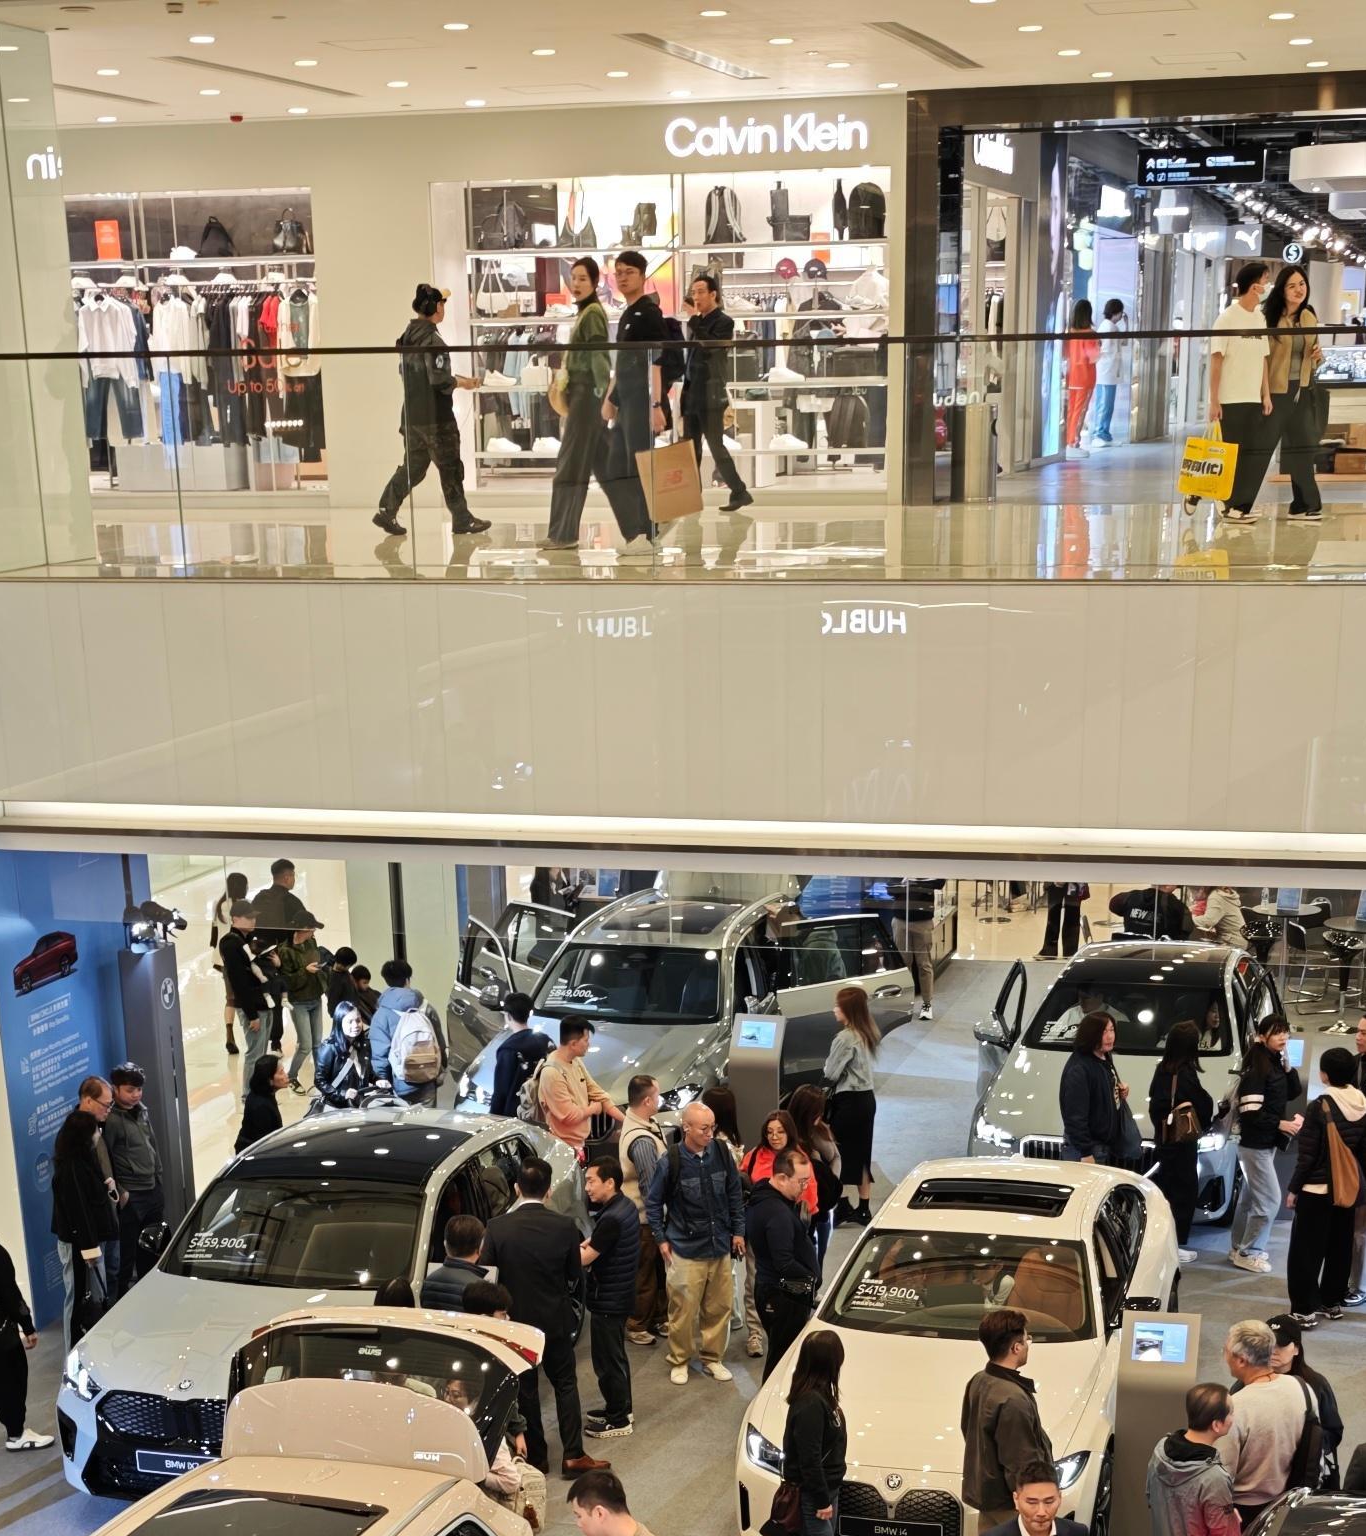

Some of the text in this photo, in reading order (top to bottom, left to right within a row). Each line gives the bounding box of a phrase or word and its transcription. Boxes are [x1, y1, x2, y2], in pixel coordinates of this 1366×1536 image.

[665, 112, 868, 157] Calvin Klein
[165, 1459, 186, 1470] BMW
[875, 1526, 898, 1536] BMW
